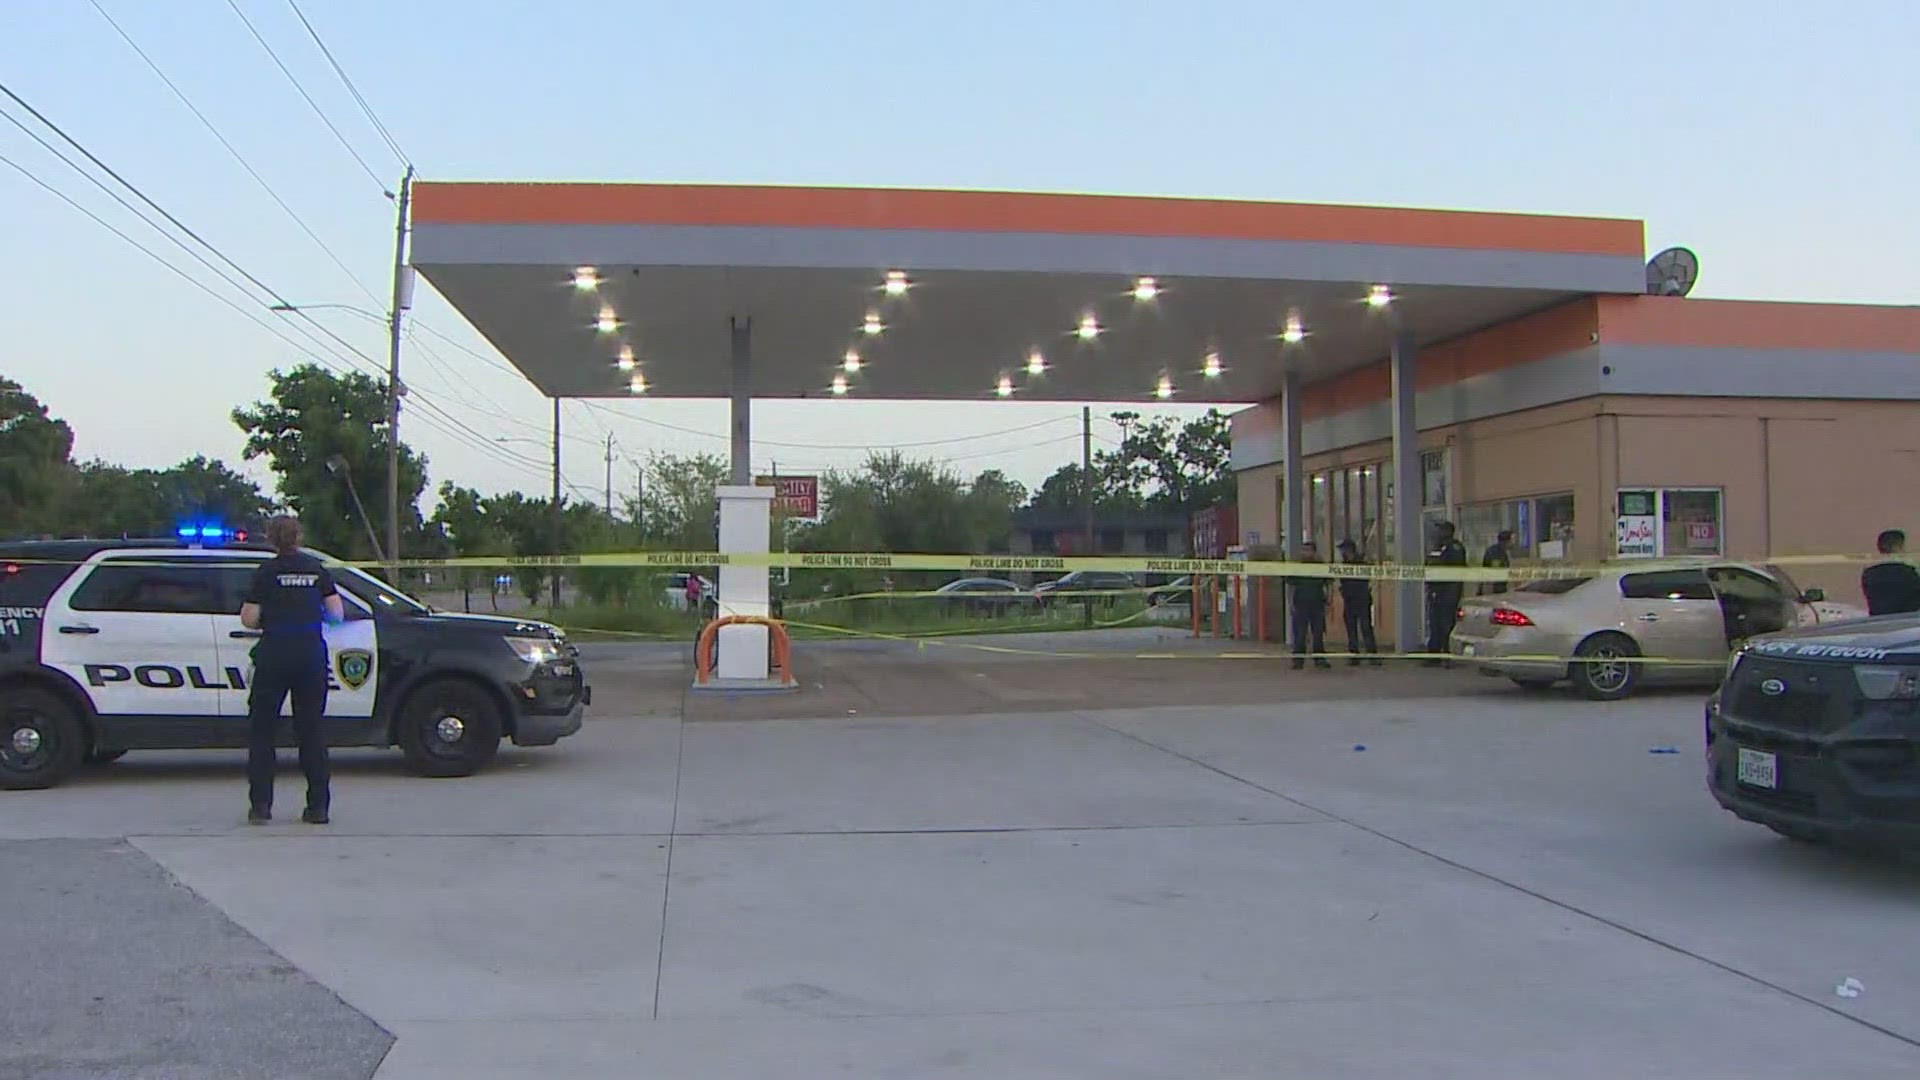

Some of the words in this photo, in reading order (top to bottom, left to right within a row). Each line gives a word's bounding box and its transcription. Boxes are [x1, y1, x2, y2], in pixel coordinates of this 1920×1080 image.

[802, 554, 826, 566] POLICE
[827, 555, 841, 566] LINE
[843, 556, 852, 566] DO
[854, 556, 868, 566] NOT
[869, 556, 891, 567] CROSS
[970, 557, 994, 568] POLICE
[996, 558, 1011, 568] LINE
[1013, 558, 1023, 568] DO
[1025, 559, 1039, 569] NOT
[1041, 559, 1064, 569] CROSS
[1147, 560, 1172, 570] POLICE
[1174, 561, 1190, 571] LINE
[1192, 561, 1202, 571] DO
[1204, 562, 1218, 572] NOT
[1221, 563, 1244, 573] CROSS
[1329, 566, 1355, 576] POLICE
